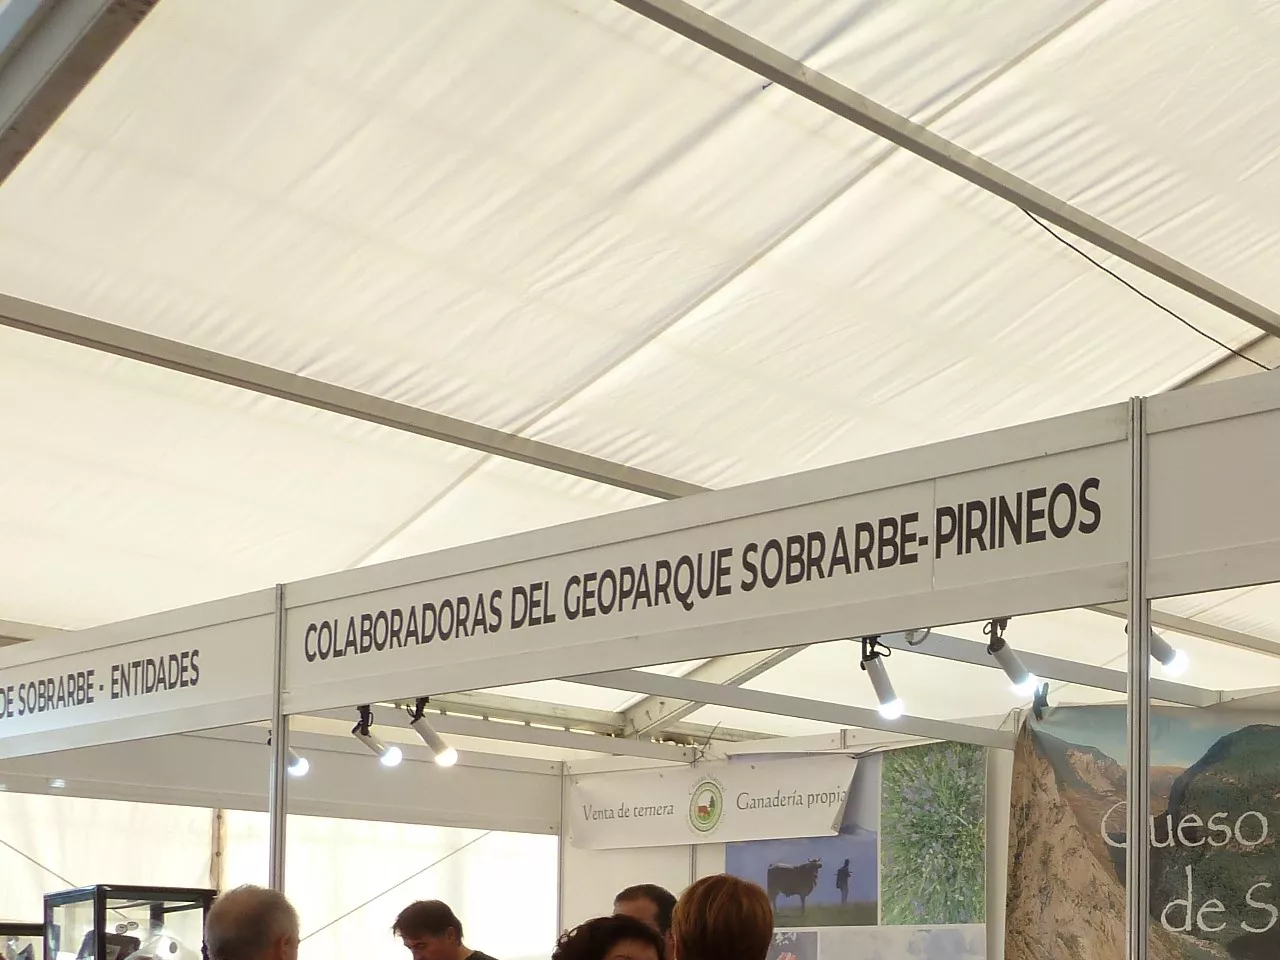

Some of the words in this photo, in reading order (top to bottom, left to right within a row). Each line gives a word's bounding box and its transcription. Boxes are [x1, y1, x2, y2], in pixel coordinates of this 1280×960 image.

[304, 588, 503, 663] COLABORADORAS
[510, 580, 556, 630] DEL
[563, 546, 733, 614] GEOPARQUE
[740, 476, 1102, 592] SOBRARBE-PIRINEOS
[18, 669, 95, 716] SOBRARBE
[111, 649, 200, 700] ENTIDADES
[583, 803, 614, 822] Venta
[617, 802, 630, 819] de
[633, 802, 675, 819] ternera
[736, 787, 803, 811] Ganadería
[1161, 864, 1226, 932] de
